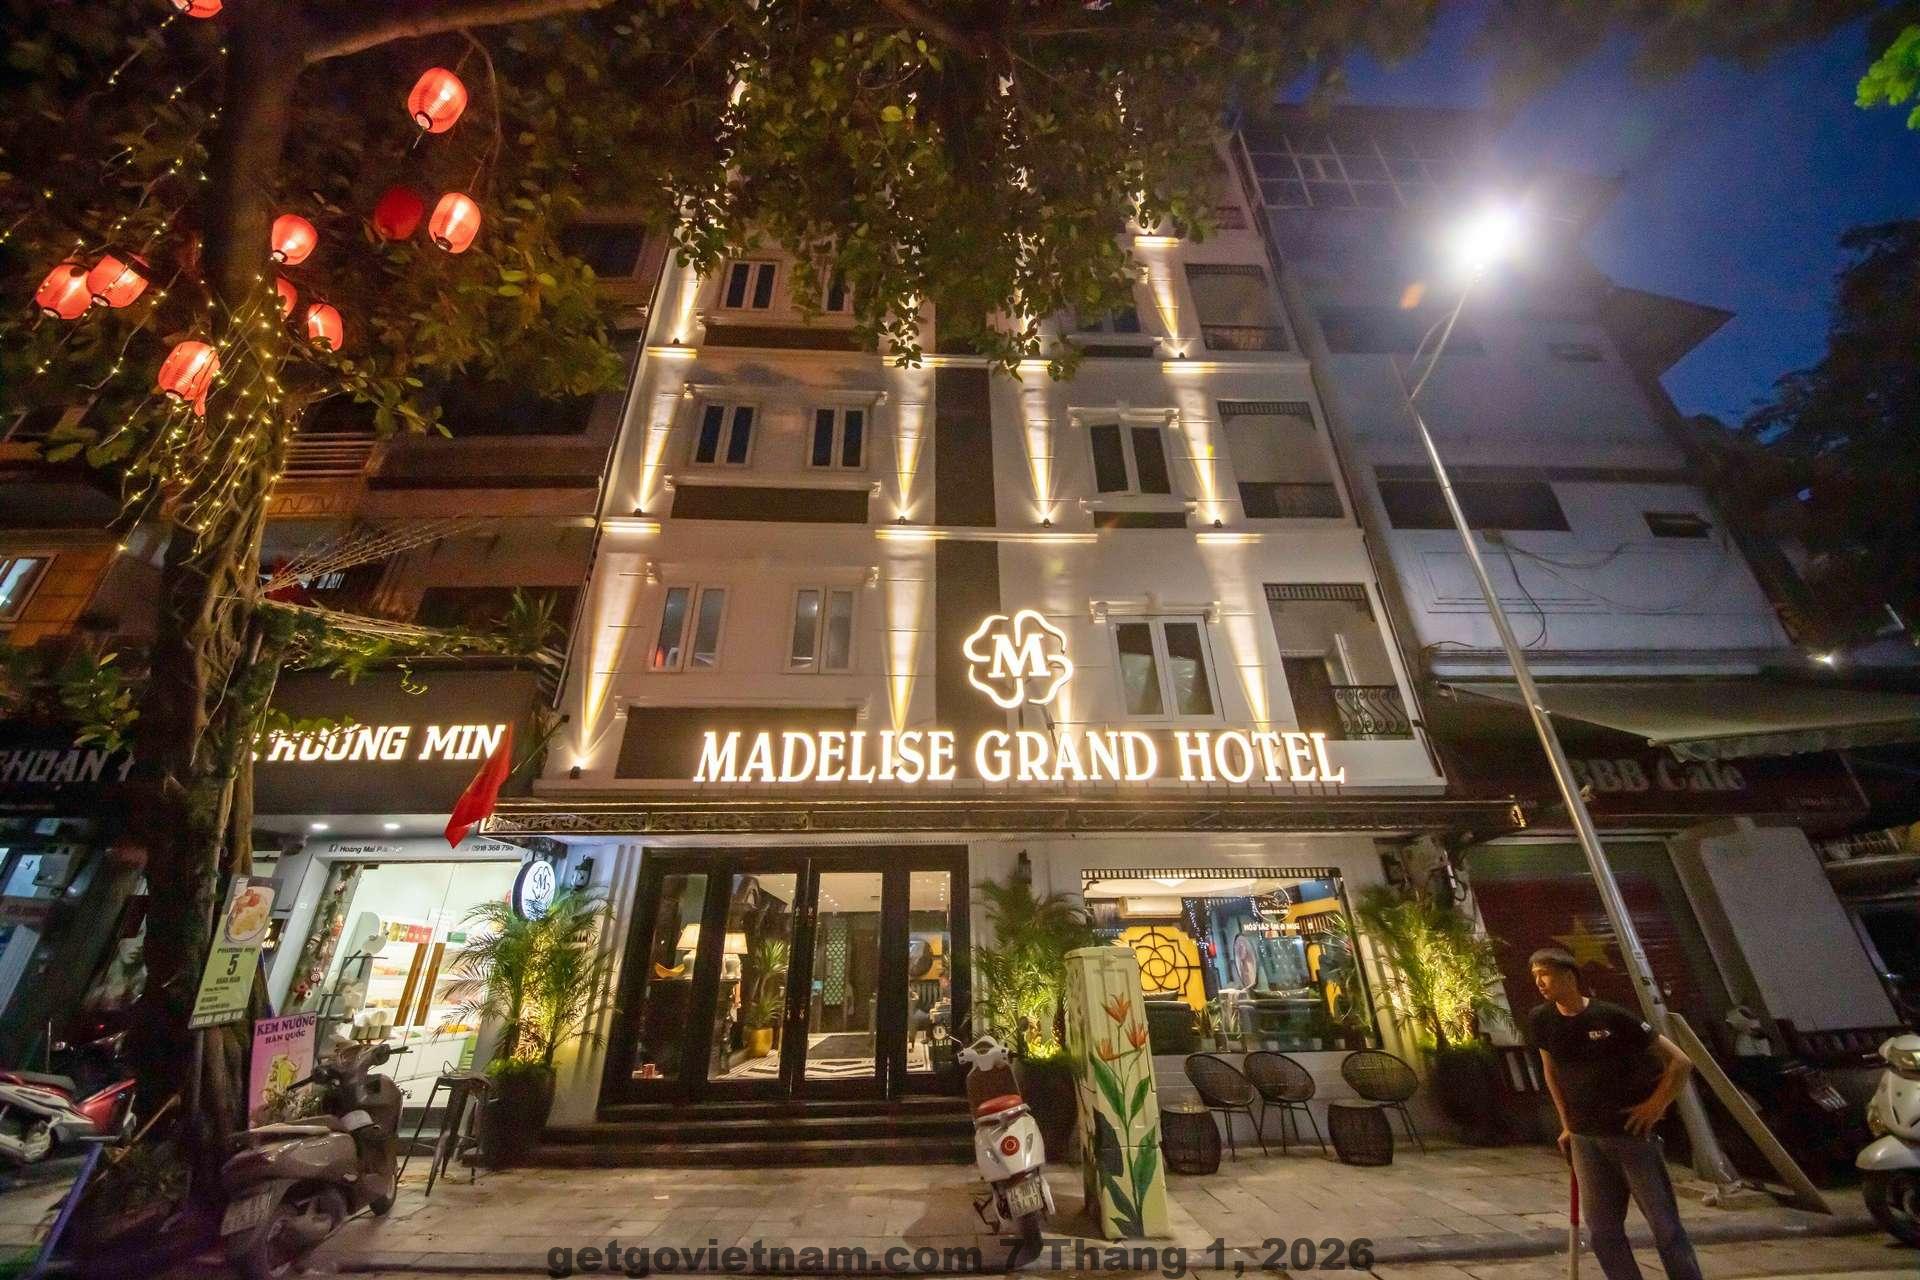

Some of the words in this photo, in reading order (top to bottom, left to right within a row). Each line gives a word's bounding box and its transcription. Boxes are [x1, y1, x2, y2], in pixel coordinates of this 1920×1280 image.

[988, 633, 1051, 679] M
[692, 730, 957, 784] MADELISE
[975, 729, 1159, 783] GRAND
[1173, 731, 1346, 784] HOTEL
[256, 1021, 280, 1037] KEM
